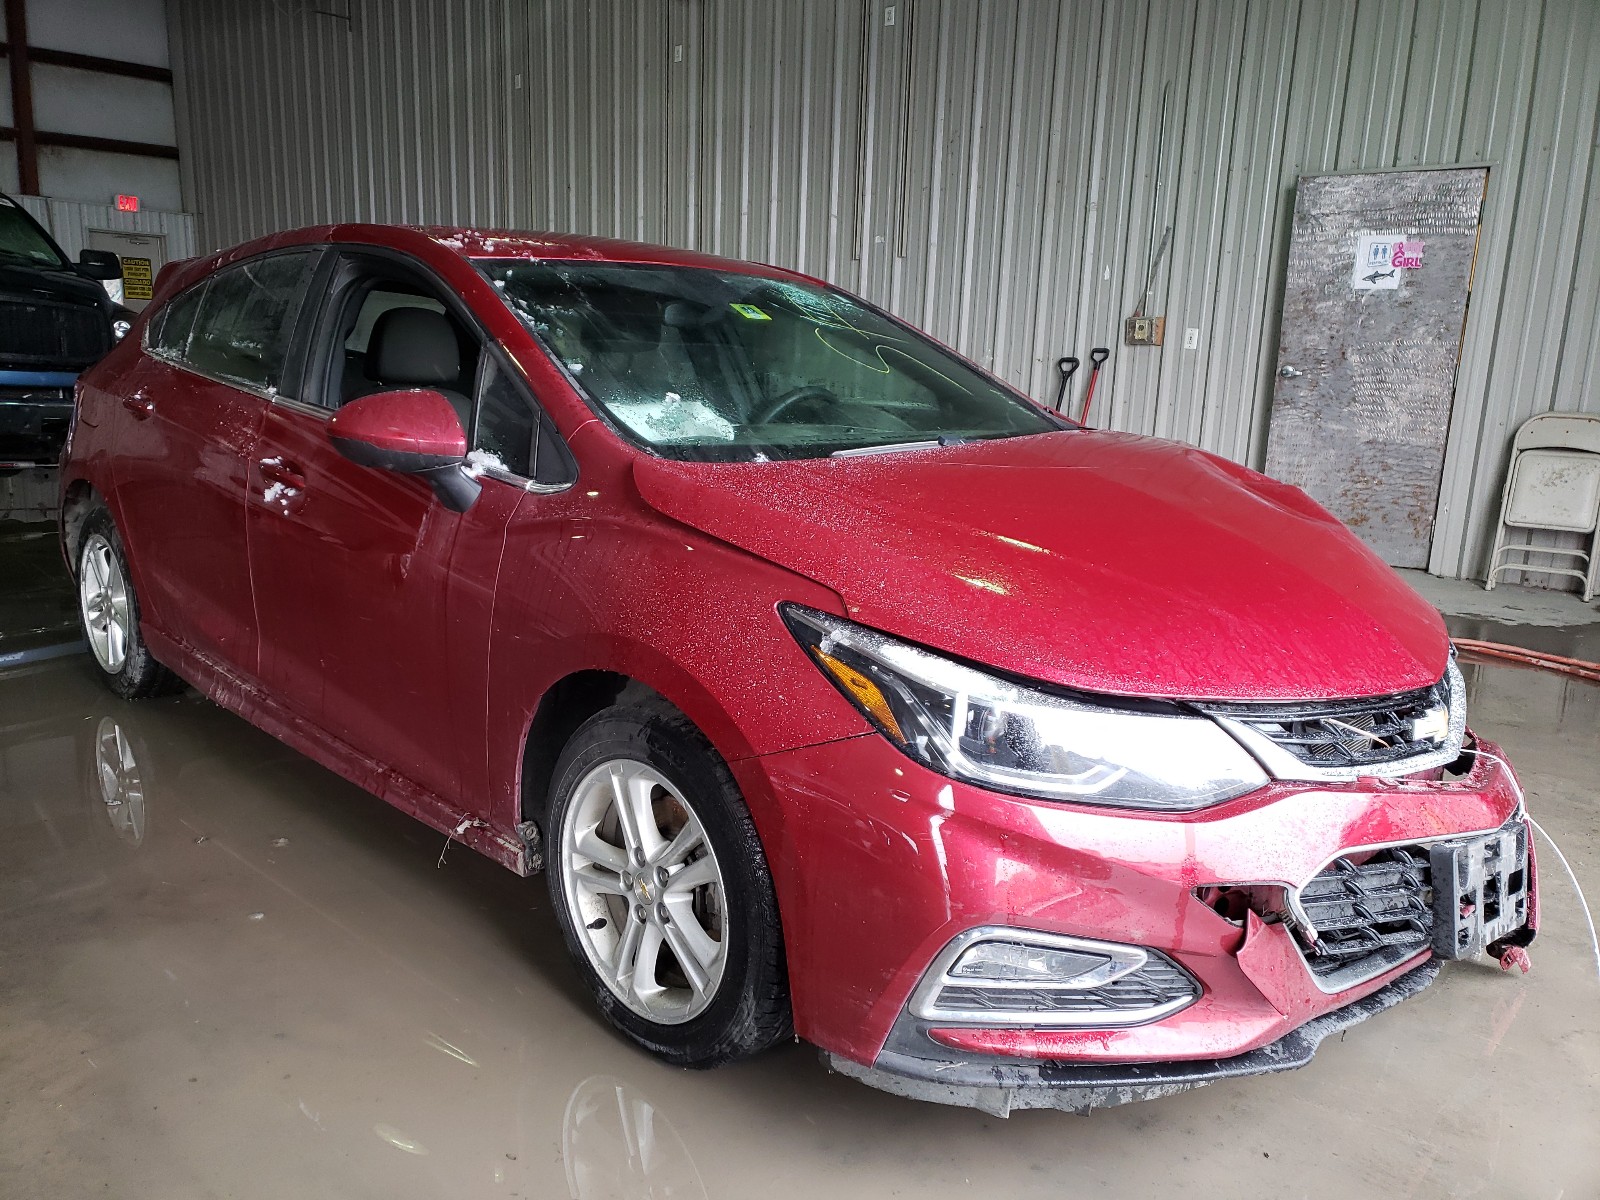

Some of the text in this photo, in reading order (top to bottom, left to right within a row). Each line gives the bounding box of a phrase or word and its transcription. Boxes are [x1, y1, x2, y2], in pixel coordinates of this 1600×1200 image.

[119, 195, 137, 211] EXIT
[123, 258, 150, 266] CAUTION
[1392, 255, 1422, 268] GIRL
